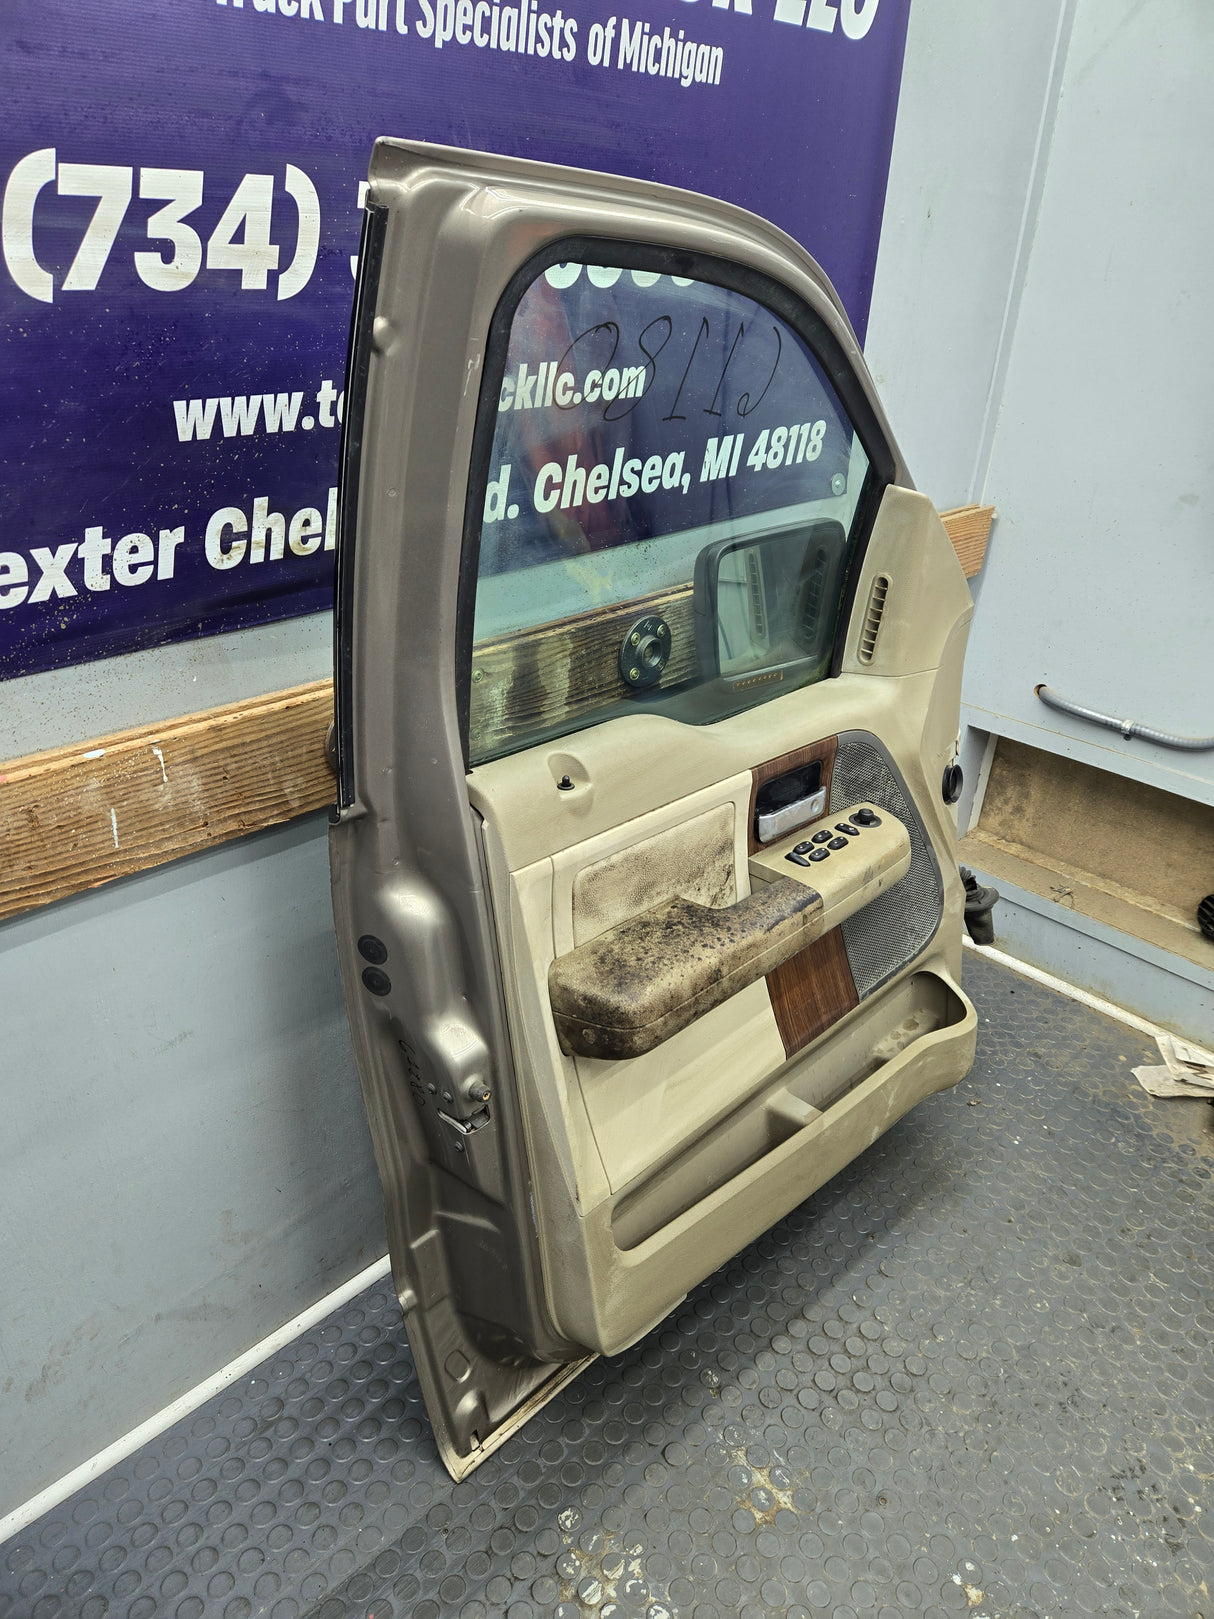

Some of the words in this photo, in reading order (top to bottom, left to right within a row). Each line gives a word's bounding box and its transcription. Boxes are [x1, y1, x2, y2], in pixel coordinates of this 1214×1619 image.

[415, 0, 578, 62] Specialists
[587, 16, 616, 67] of
[618, 18, 723, 87] Michigan
[2, 147, 320, 303] (734)
[0, 526, 185, 609] exter
[205, 487, 338, 570] Chel
[534, 447, 691, 513] Chelsea,
[700, 433, 745, 482] MI
[746, 419, 827, 471] 48118
